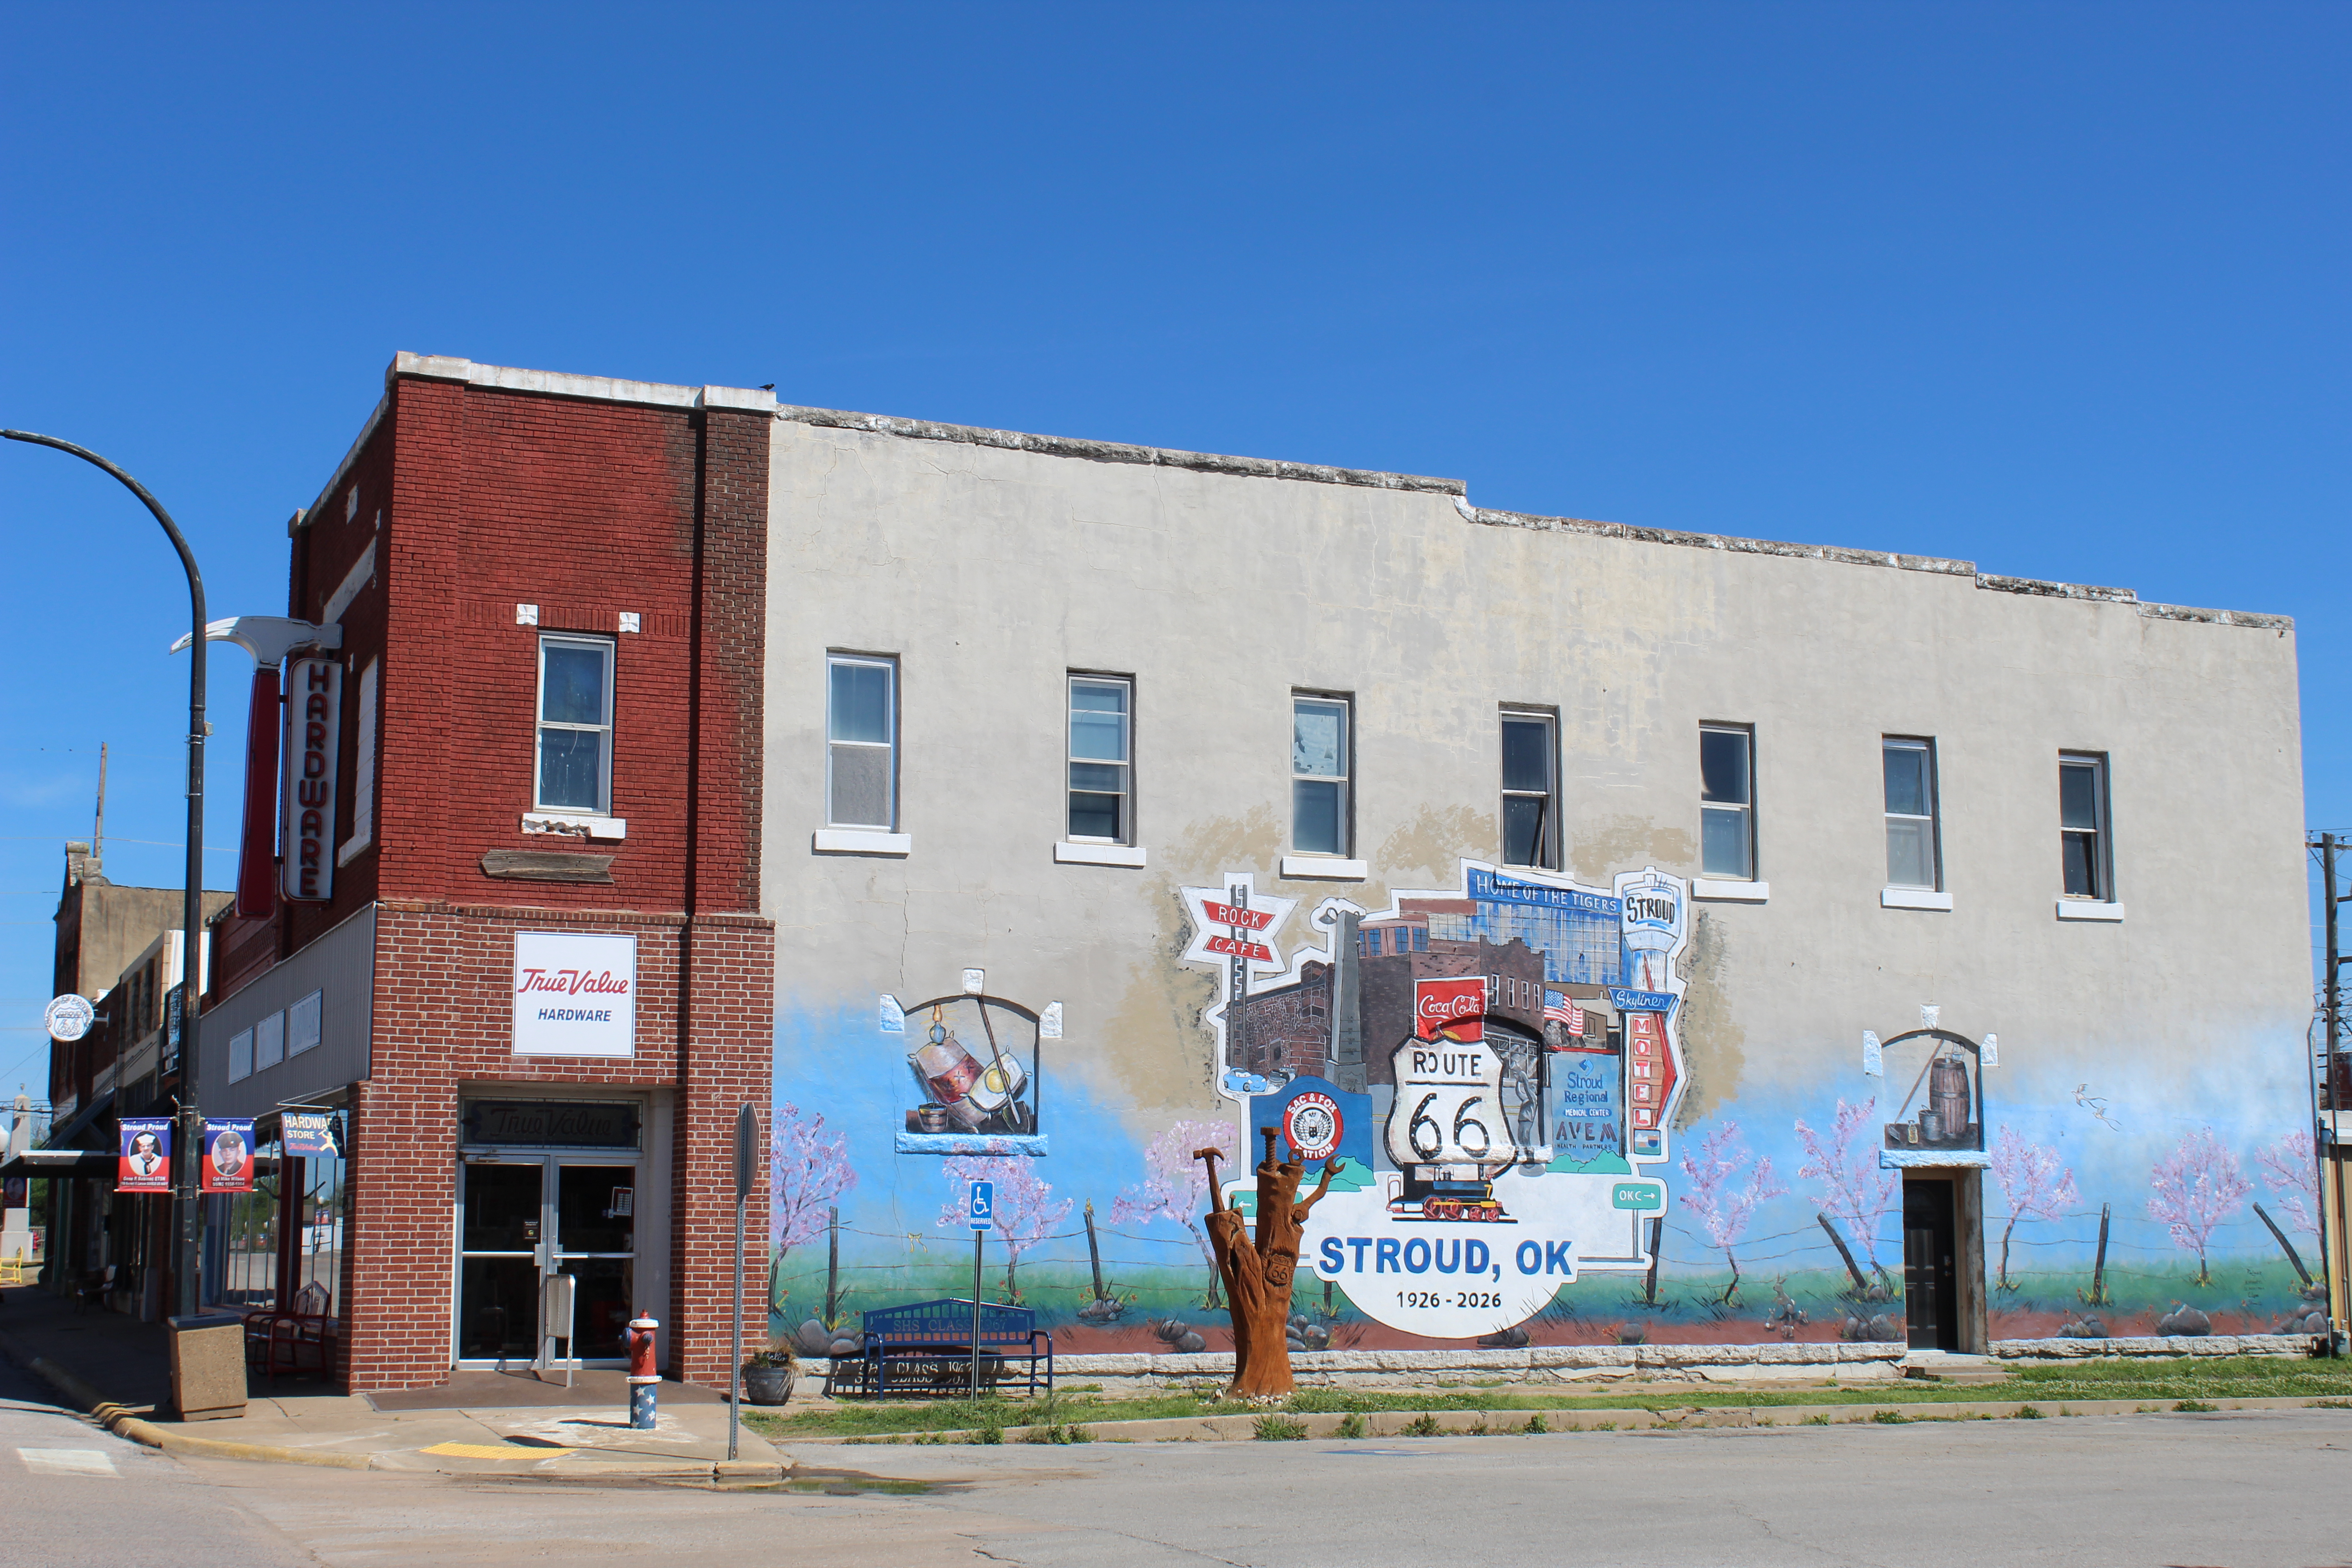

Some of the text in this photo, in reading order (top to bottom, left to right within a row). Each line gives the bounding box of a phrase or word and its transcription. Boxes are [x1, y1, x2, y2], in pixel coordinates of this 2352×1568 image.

[299, 664, 330, 895] HARDWARE
[1476, 874, 1617, 911] HOME OF THE TIGERS
[1219, 906, 1260, 927] ROCK
[1627, 897, 1676, 924] STROUD
[1215, 939, 1260, 957] CAFE
[517, 969, 629, 995] True Value
[1419, 994, 1480, 1019] Coca-Cola
[1616, 990, 1666, 1009] Skyliner
[538, 1008, 612, 1021] HARDWARE
[1413, 1050, 1482, 1077] ROUTE
[1634, 1019, 1650, 1125] MOTEL
[1567, 1071, 1603, 1089] Stroud
[1287, 1093, 1338, 1114] SAC & FOX
[1564, 1090, 1608, 1105] Regional
[1565, 1108, 1588, 1117] MEDICAL
[284, 1115, 340, 1130] HARDWARE
[490, 1108, 612, 1137] True Value
[1408, 1093, 1491, 1160] 66
[1556, 1121, 1617, 1142] AVEM
[287, 1130, 315, 1139] STORE
[1484, 1184, 1493, 1199] 7
[1619, 1190, 1642, 1201] OKC
[1319, 1236, 1573, 1283] STROUD, OK
[1271, 1266, 1288, 1280] 66
[1396, 1291, 1440, 1308] 1926
[1457, 1292, 1502, 1308] 2026
[894, 1319, 1007, 1332] SHS CLASS 1967
[767, 1352, 787, 1362] hello
